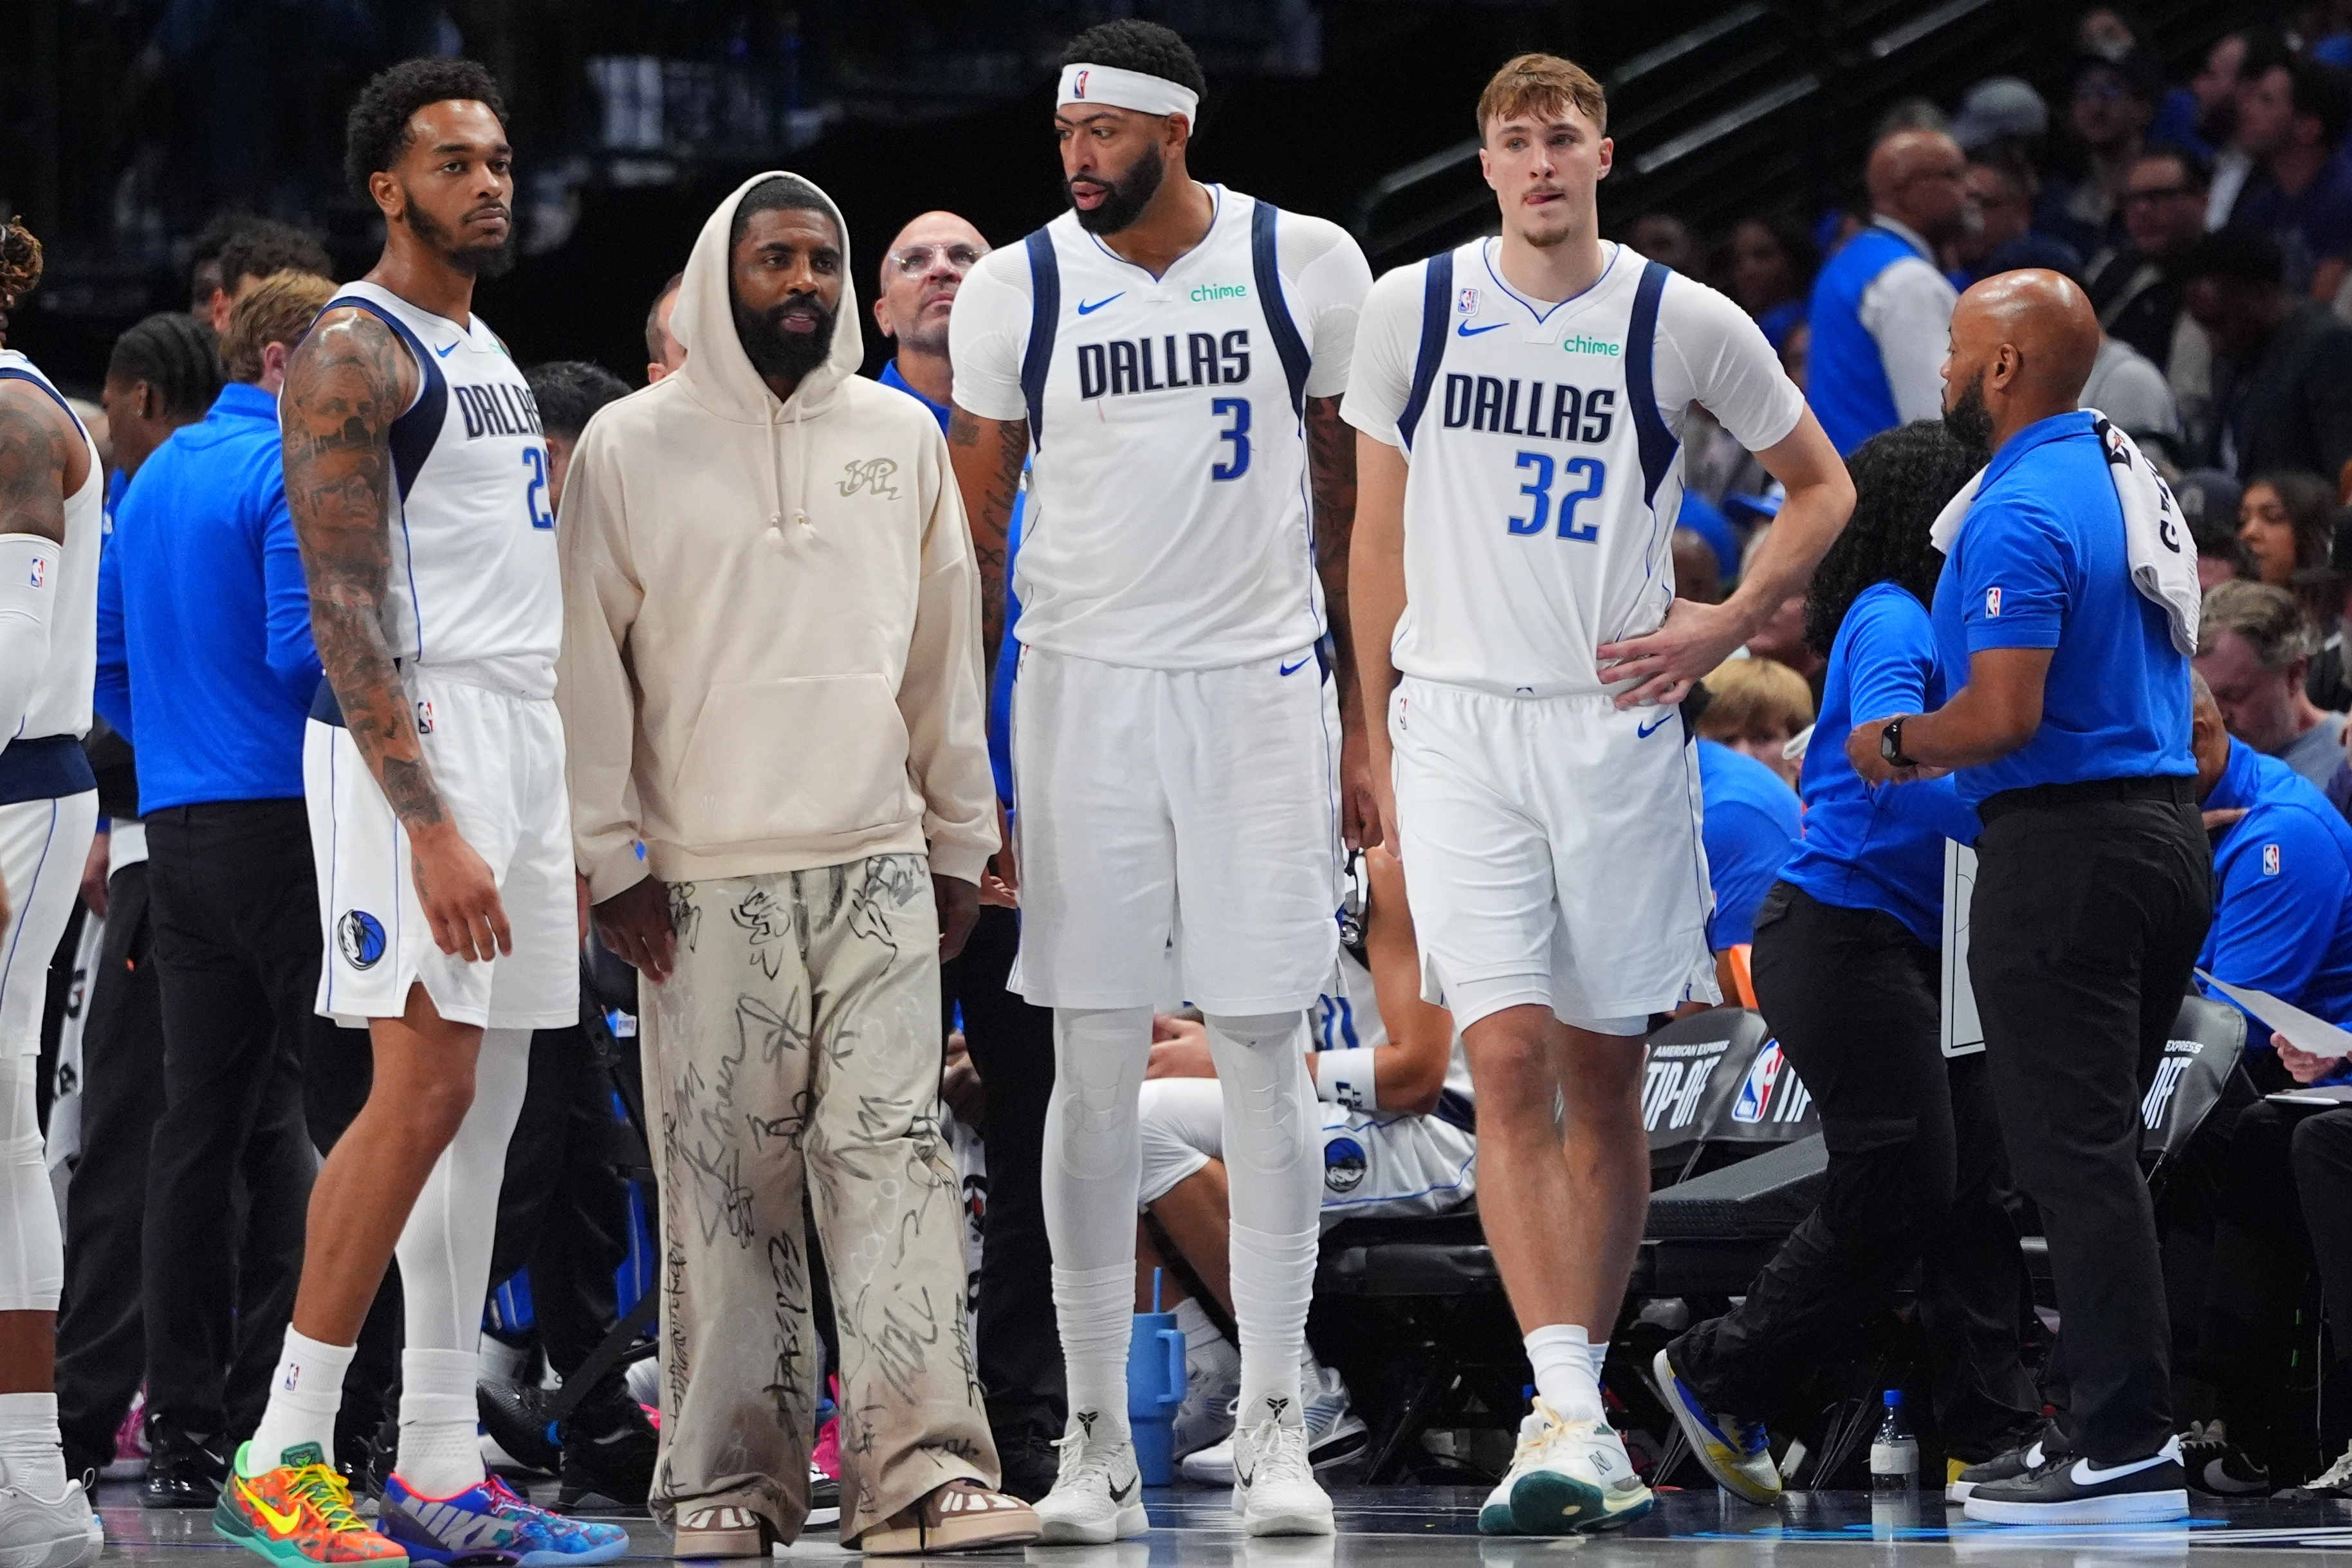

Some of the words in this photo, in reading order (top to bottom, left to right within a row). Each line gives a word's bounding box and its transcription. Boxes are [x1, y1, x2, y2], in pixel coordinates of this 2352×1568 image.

[1190, 284, 1247, 303] chime
[1077, 329, 1251, 402] DALLAS
[1563, 335, 1620, 356] chime
[1211, 396, 1252, 482] 3
[1442, 371, 1617, 446] DALLAS
[522, 446, 555, 531] 2
[1507, 450, 1608, 545] 32
[1653, 1044, 1698, 1058] AMERICAN
[1696, 1039, 1731, 1057] EXPRESS
[2164, 1039, 2205, 1054] EXPRESS
